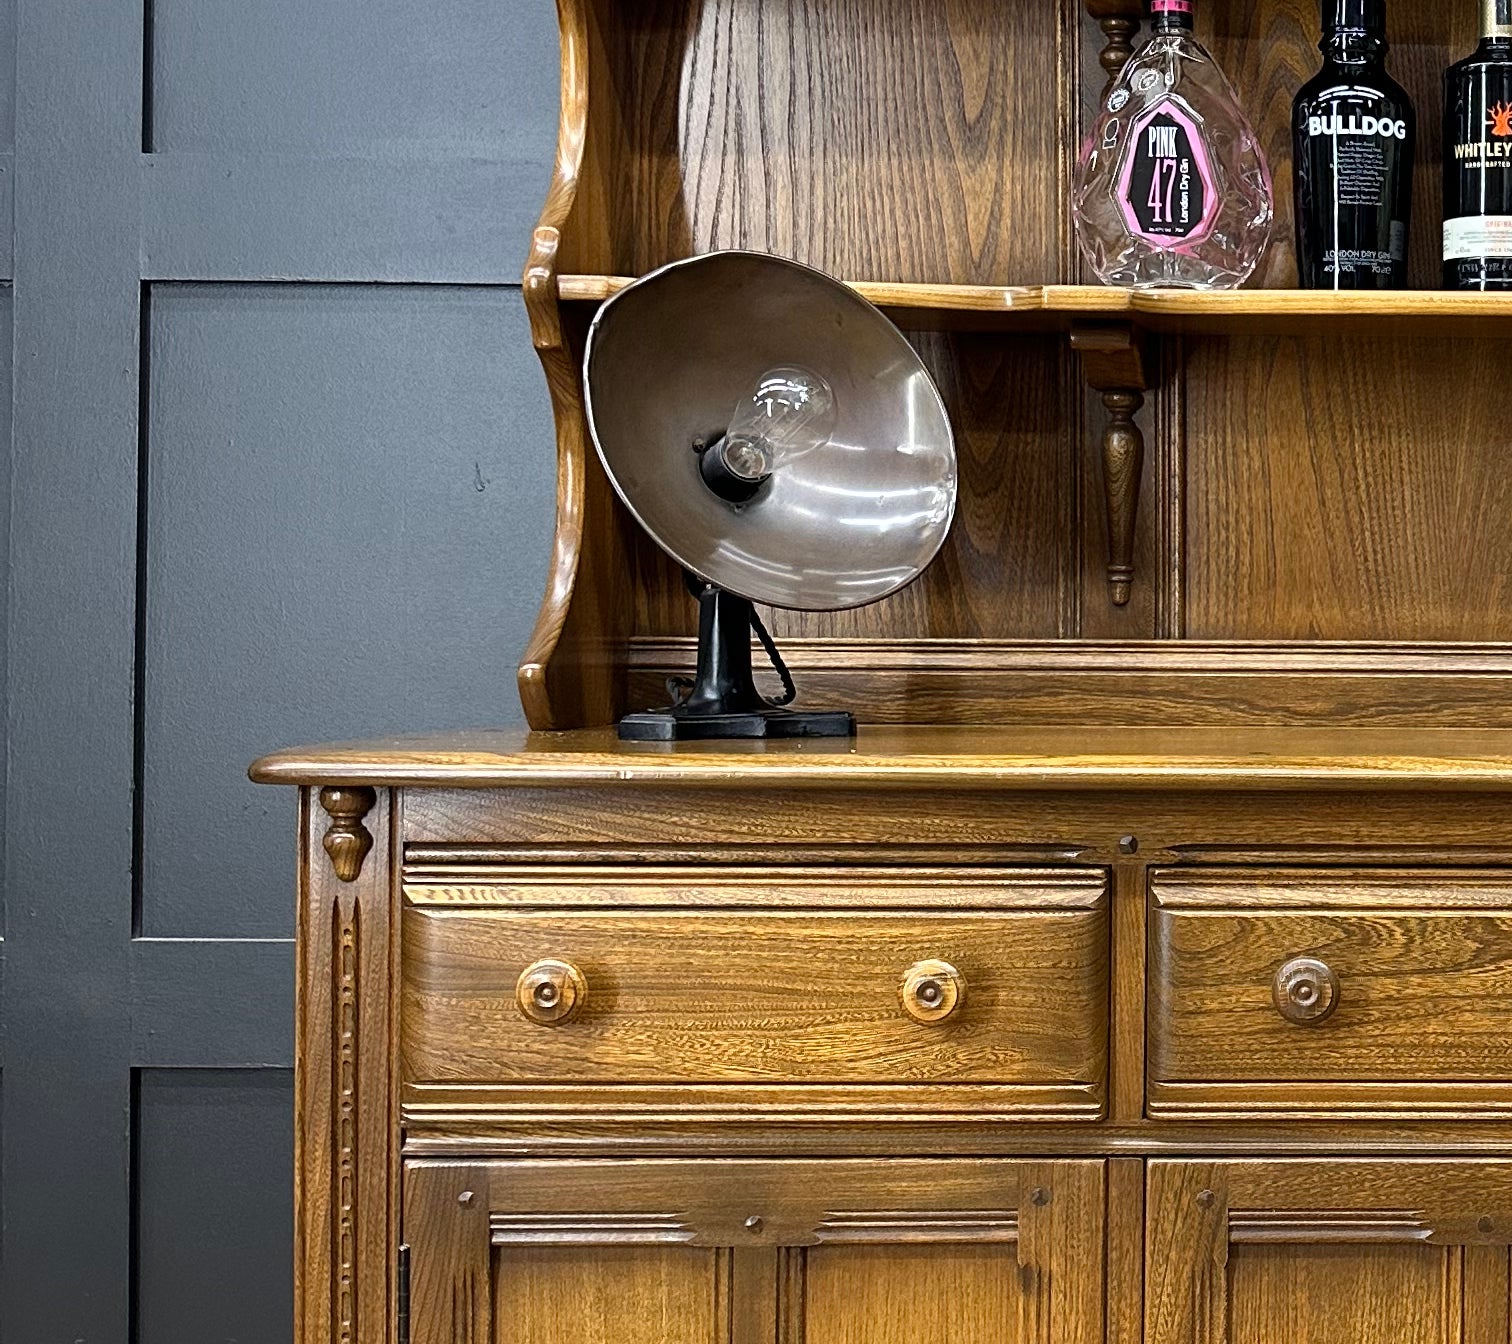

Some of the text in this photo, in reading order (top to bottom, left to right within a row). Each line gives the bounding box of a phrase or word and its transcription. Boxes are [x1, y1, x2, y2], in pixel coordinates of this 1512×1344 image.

[1308, 114, 1406, 139] BULLDOG
[1147, 126, 1178, 158] PINK
[1453, 142, 1512, 160] WHITLEY
[1147, 158, 1178, 224] 47
[1180, 173, 1190, 190] Dry
[1180, 191, 1189, 223] London
